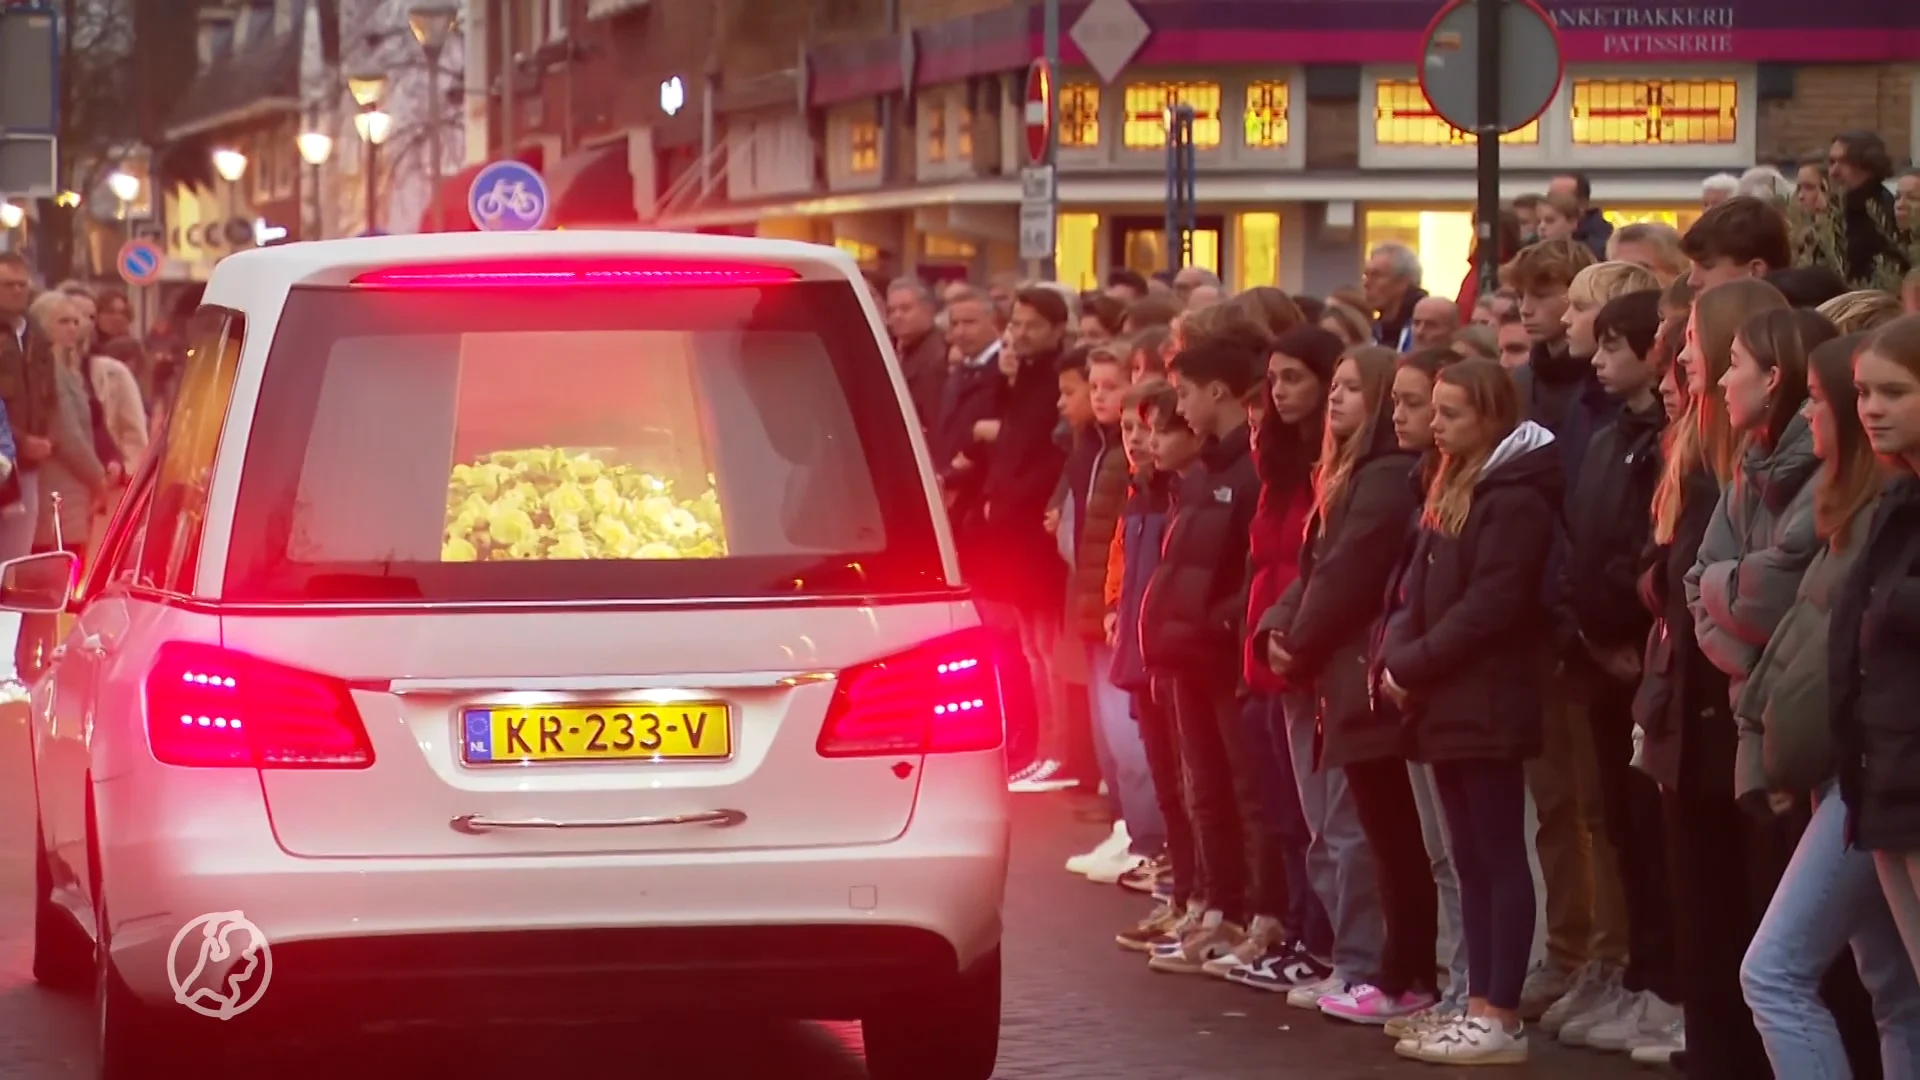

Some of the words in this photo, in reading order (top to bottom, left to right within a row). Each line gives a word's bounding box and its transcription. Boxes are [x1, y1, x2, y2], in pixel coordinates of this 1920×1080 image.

[1548, 7, 1734, 27] ANKETBAKKERIJ
[1603, 34, 1733, 53] PATISSERIE
[506, 712, 708, 754] KR-233-V
[470, 741, 489, 753] NL
